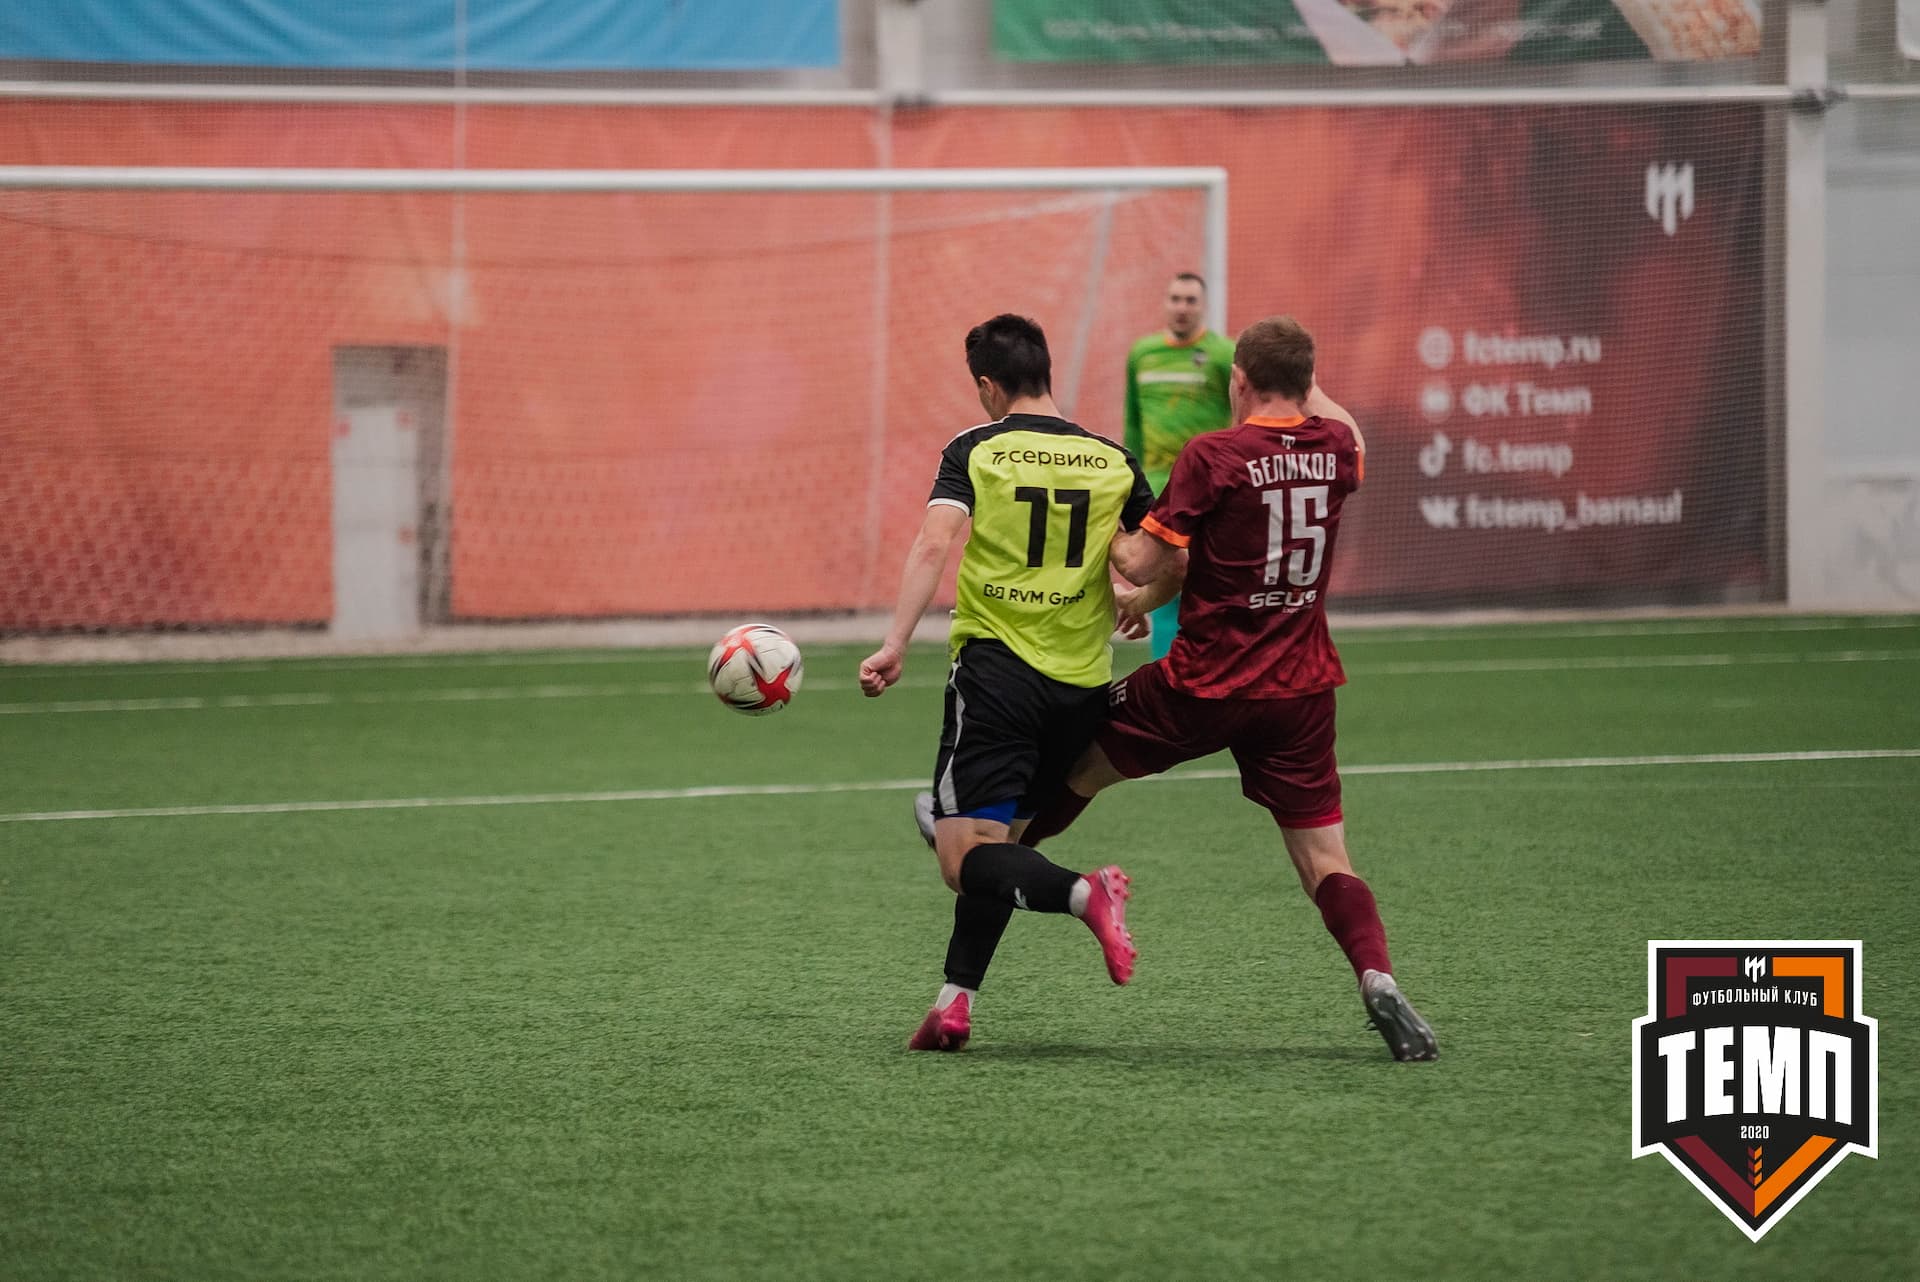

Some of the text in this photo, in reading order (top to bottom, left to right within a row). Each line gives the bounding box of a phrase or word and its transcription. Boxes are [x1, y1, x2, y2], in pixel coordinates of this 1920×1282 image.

[1008, 450, 1108, 470] сервико
[1246, 453, 1337, 487] БЕЛИКОВ
[1014, 486, 1091, 568] 11
[1261, 485, 1329, 586] 15
[1008, 588, 1044, 604] RVM
